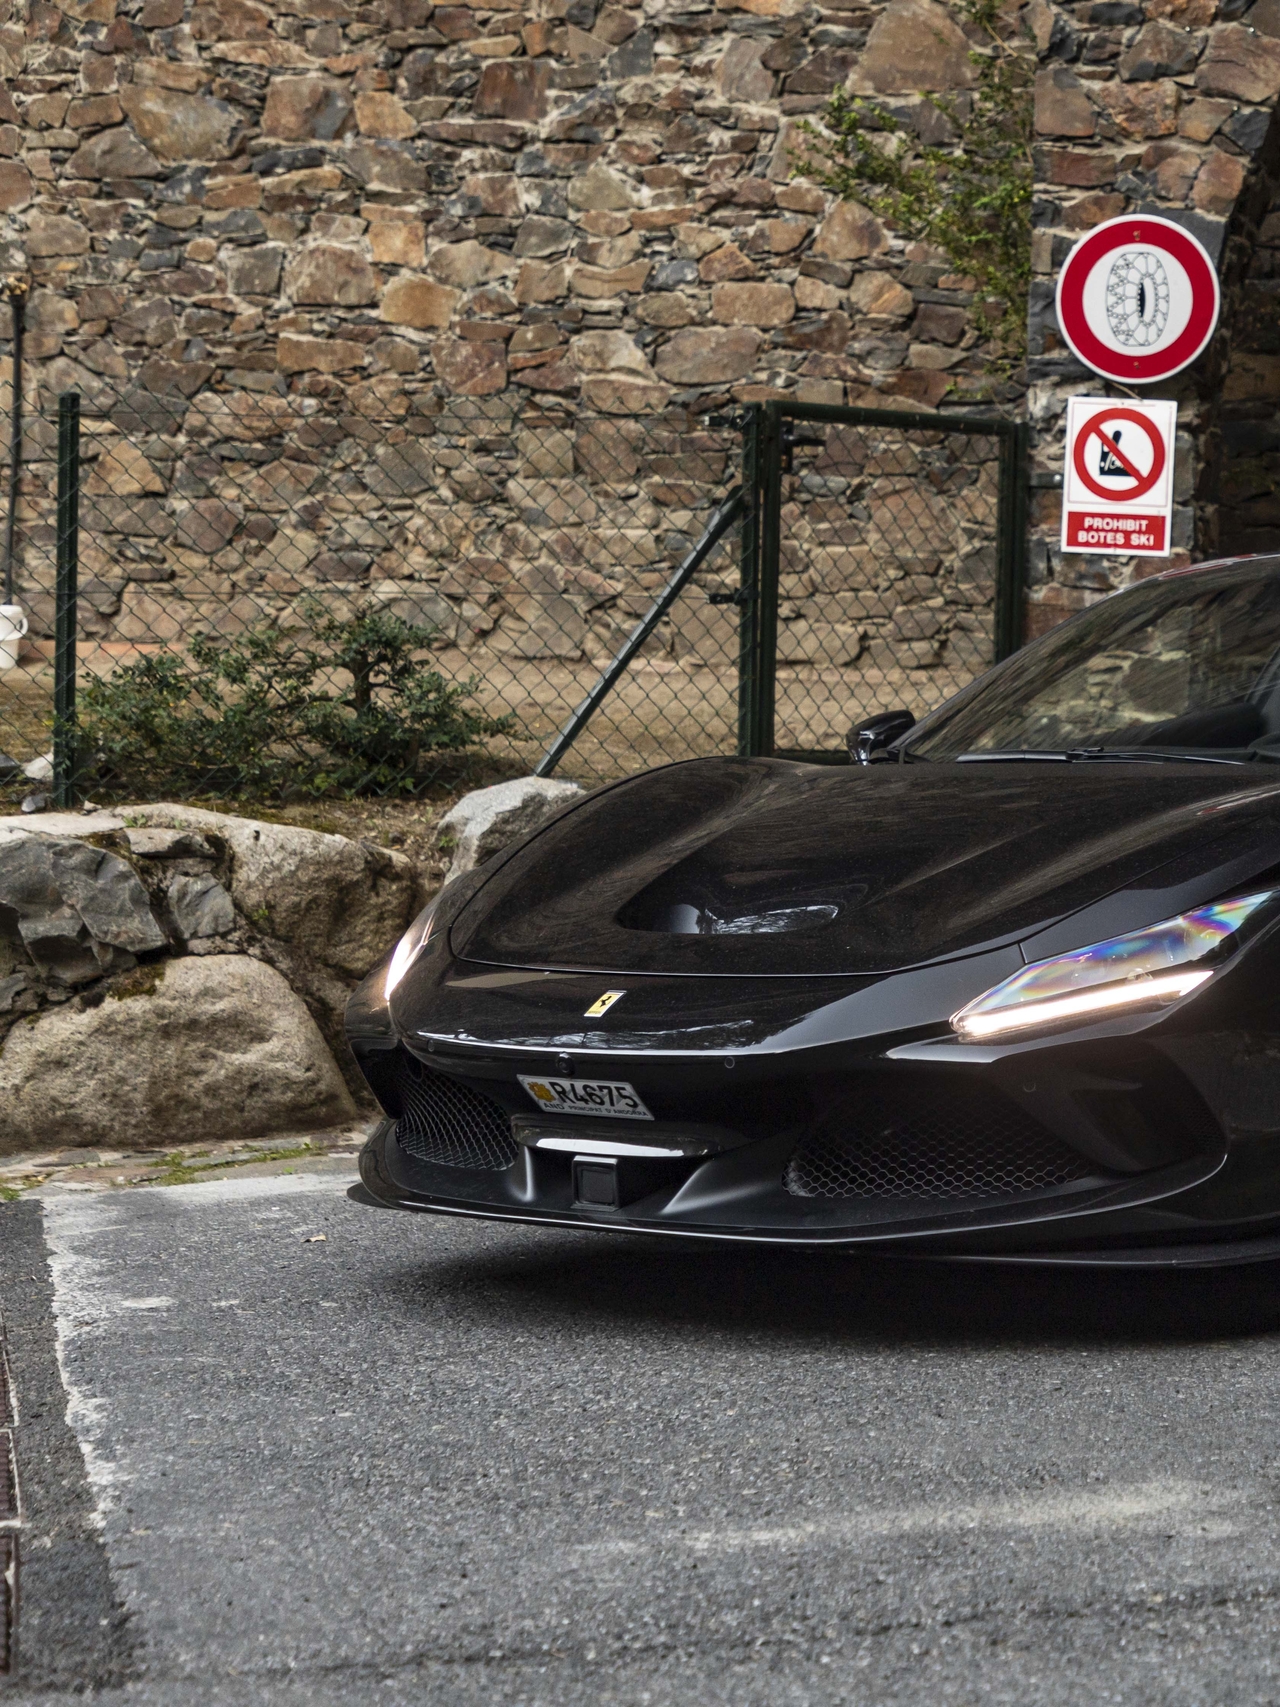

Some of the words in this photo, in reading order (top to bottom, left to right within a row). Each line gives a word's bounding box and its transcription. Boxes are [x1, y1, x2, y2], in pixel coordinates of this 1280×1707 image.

[1084, 517, 1149, 532] PROHIBIT
[1077, 530, 1125, 545] BOTES
[1130, 533, 1154, 546] SKI
[548, 1081, 639, 1108] R4675
[543, 1102, 565, 1110] AND
